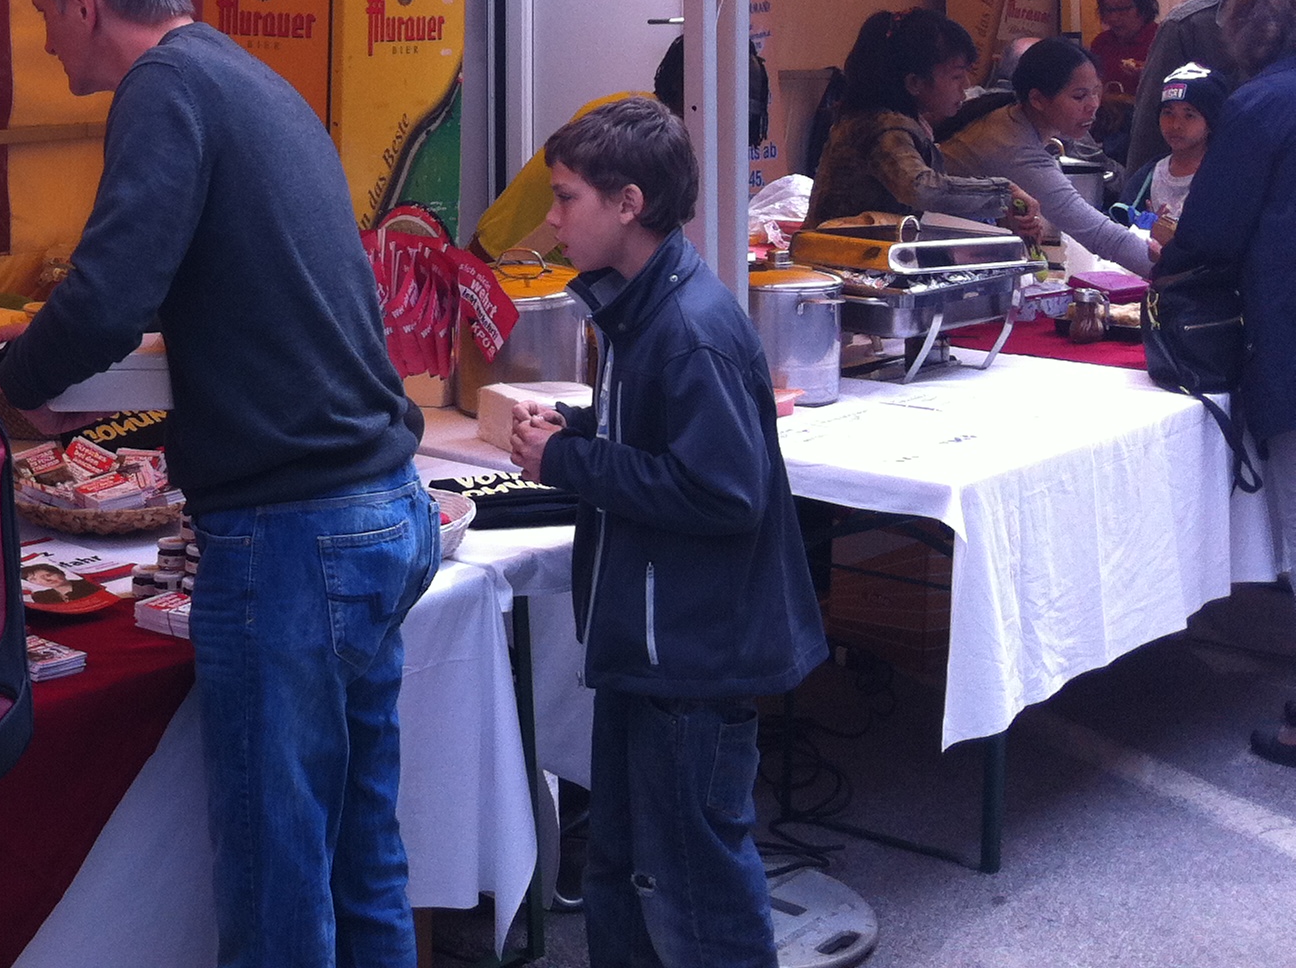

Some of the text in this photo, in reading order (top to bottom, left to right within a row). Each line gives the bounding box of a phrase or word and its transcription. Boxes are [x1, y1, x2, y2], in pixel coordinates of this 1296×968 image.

[247, 40, 280, 50] BIER
[392, 46, 420, 55] BIER
[382, 113, 410, 171] Beste
[763, 142, 778, 160] ab
